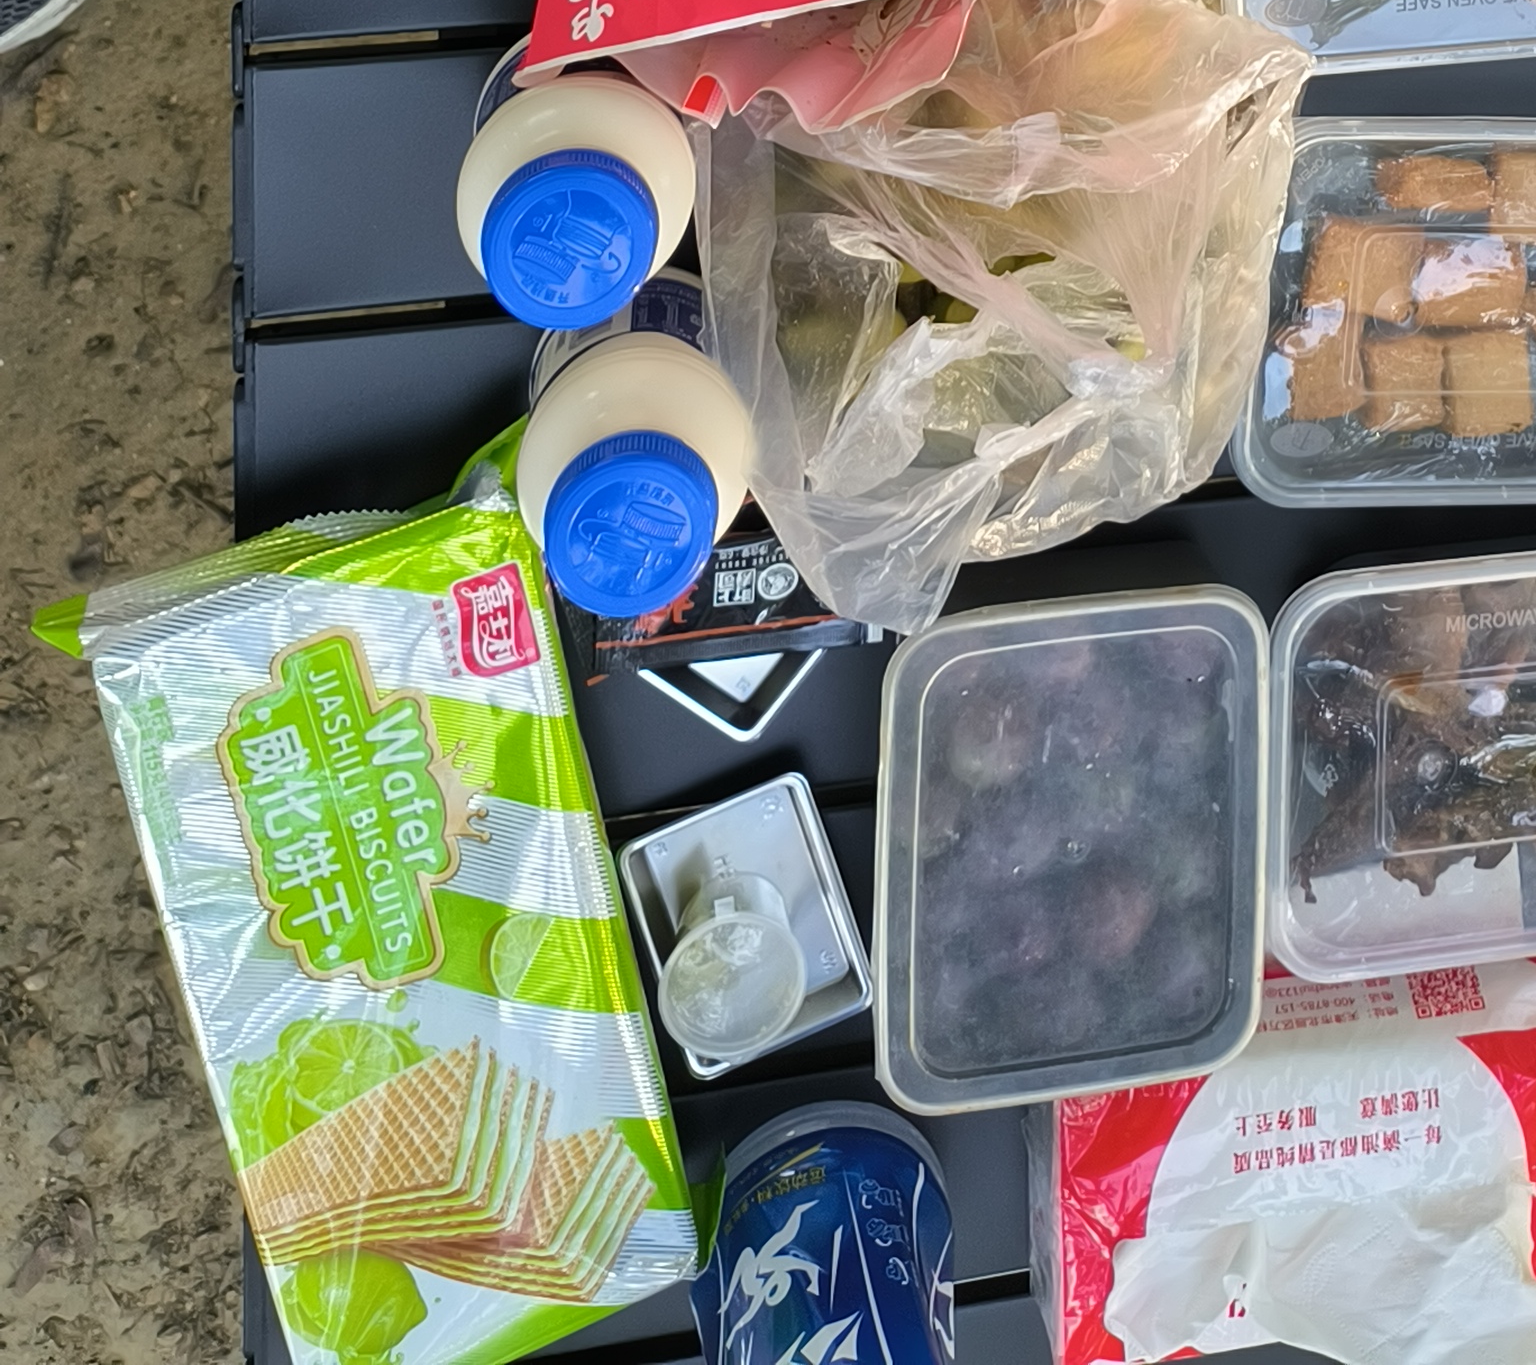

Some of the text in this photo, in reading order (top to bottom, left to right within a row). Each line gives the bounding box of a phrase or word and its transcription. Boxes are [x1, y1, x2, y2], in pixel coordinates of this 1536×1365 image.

[463, 575, 522, 669] 嘉士利
[307, 668, 413, 953] JIASHILI BISCUITS
[364, 706, 437, 867] Wafer
[240, 724, 355, 937] 威化饼干
[1274, 997, 1356, 1015] 400-8785-157
[1234, 1087, 1440, 1137] 让您满意 服务至上
[758, 1166, 826, 1203] 运动饮料
[1233, 1124, 1442, 1174] 每一滴油都是精纯品质
